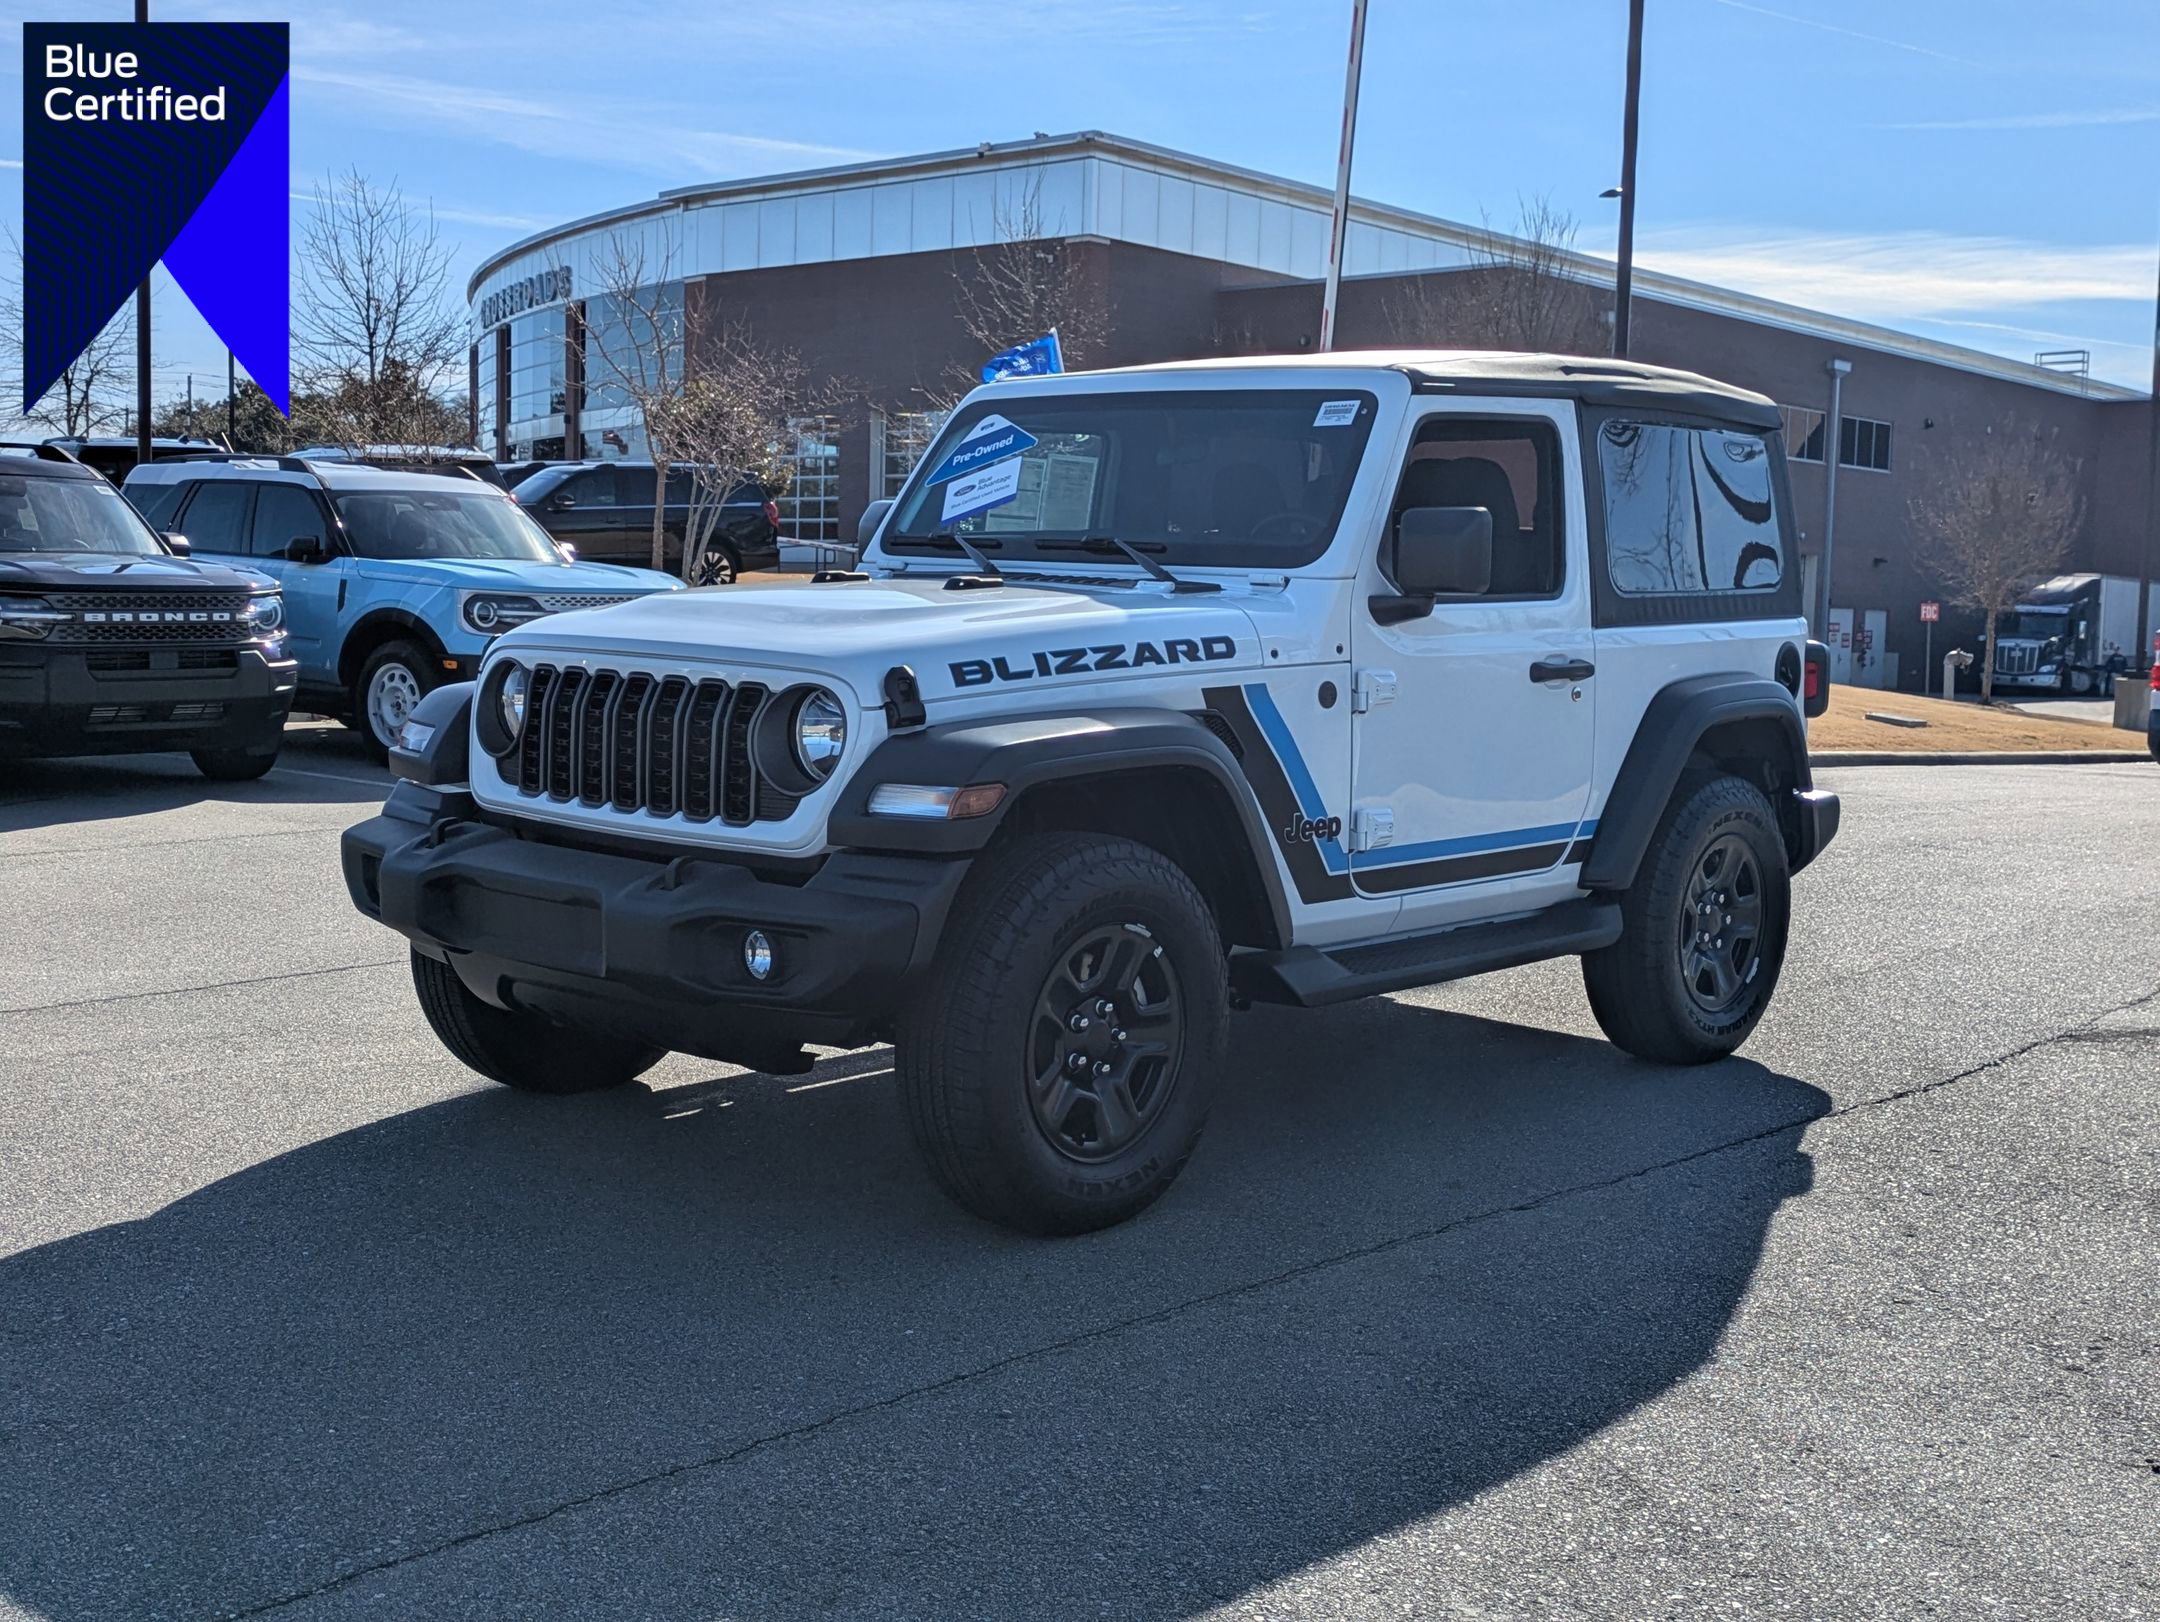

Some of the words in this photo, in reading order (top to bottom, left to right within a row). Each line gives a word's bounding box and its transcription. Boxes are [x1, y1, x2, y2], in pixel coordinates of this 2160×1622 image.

[952, 434, 1015, 466] Pre-Owned
[84, 613, 231, 622] BRONCO
[1921, 604, 1938, 619] FDC
[947, 635, 1237, 688] BLIZZARD
[1283, 812, 1342, 844] Jeep
[1711, 810, 1763, 832] NEXEN
